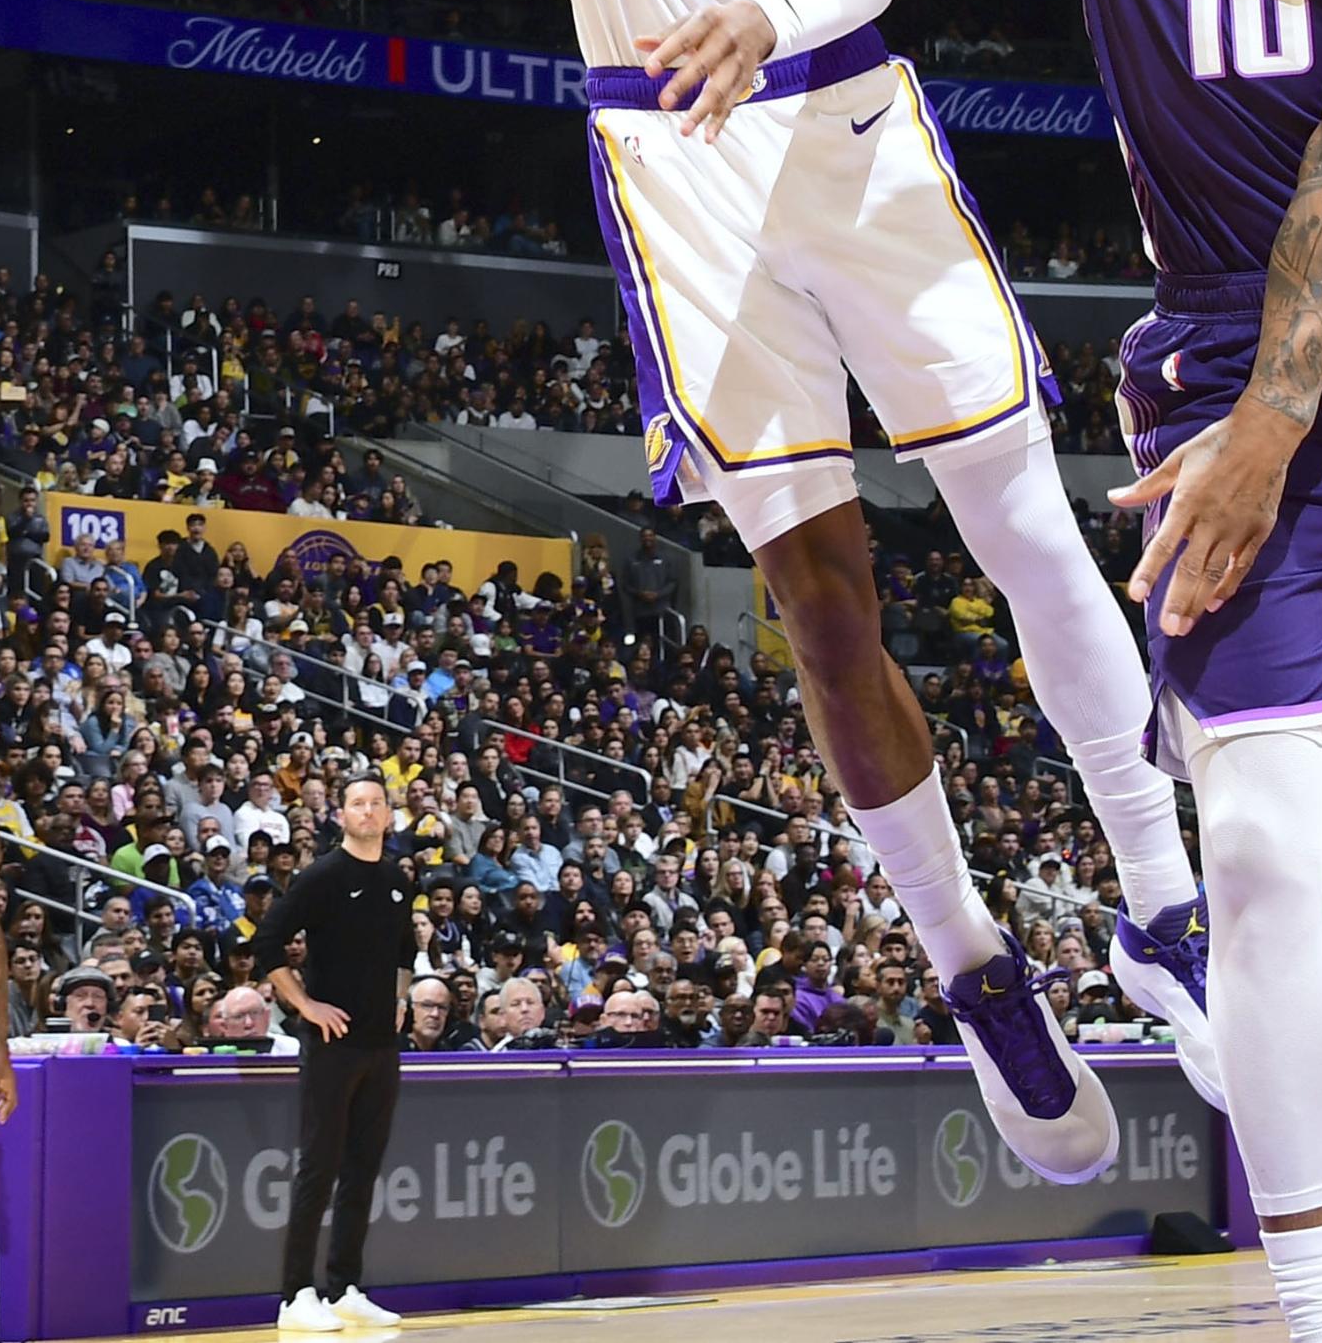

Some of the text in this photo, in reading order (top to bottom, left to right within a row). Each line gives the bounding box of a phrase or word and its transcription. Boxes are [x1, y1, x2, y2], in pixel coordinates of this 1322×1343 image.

[167, 15, 588, 105] Michelob ULTR
[922, 80, 1096, 135] Michelob
[67, 513, 119, 544] 103
[434, 1135, 537, 1220] Life
[657, 1122, 898, 1207] Globe Life
[1128, 1113, 1200, 1181] Life
